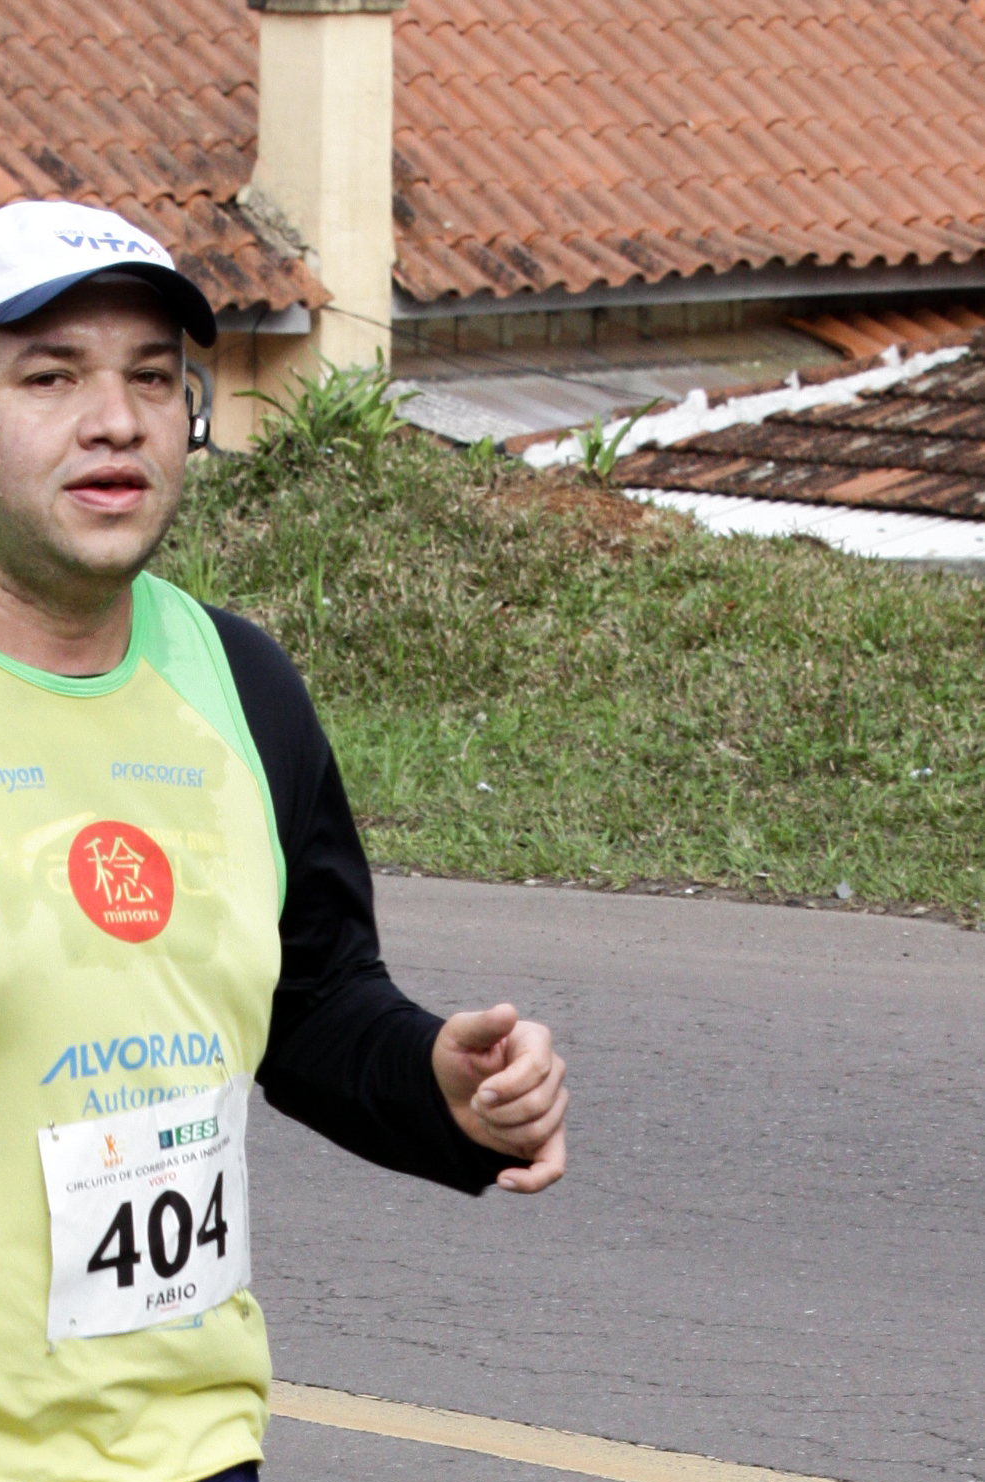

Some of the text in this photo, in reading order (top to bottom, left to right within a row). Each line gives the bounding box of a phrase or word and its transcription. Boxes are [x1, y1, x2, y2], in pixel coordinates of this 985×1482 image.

[111, 761, 205, 788] procorrer
[104, 905, 159, 923] minoru
[39, 1033, 225, 1086] ALVORADA
[66, 1173, 117, 1193] CIRCUITO
[118, 1170, 132, 1181] DE
[135, 1156, 180, 1178] CORRDAS
[182, 1152, 198, 1164] DA
[87, 1170, 229, 1289] 404
[146, 1283, 198, 1311] FABIO
